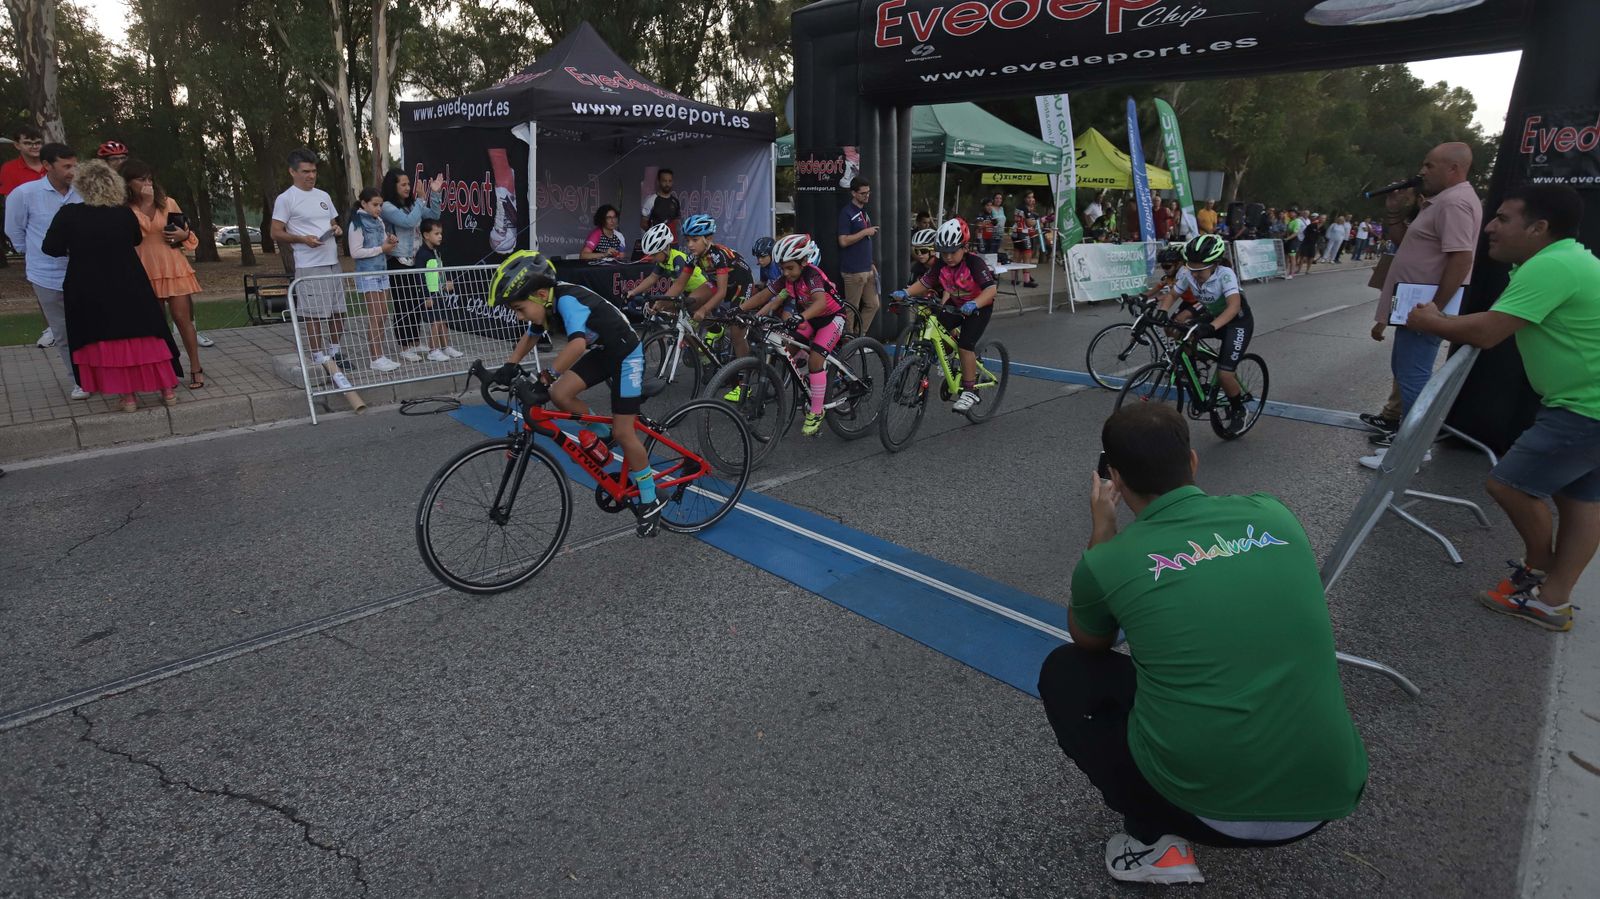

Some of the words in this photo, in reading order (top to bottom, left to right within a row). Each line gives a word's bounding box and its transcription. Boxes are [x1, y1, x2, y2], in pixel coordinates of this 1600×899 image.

[1137, 6, 1207, 27] Chip
[920, 37, 1259, 83] www.evedeport.es
[413, 99, 510, 121] www.evedeport.es
[571, 102, 750, 129] www.evedeport.es
